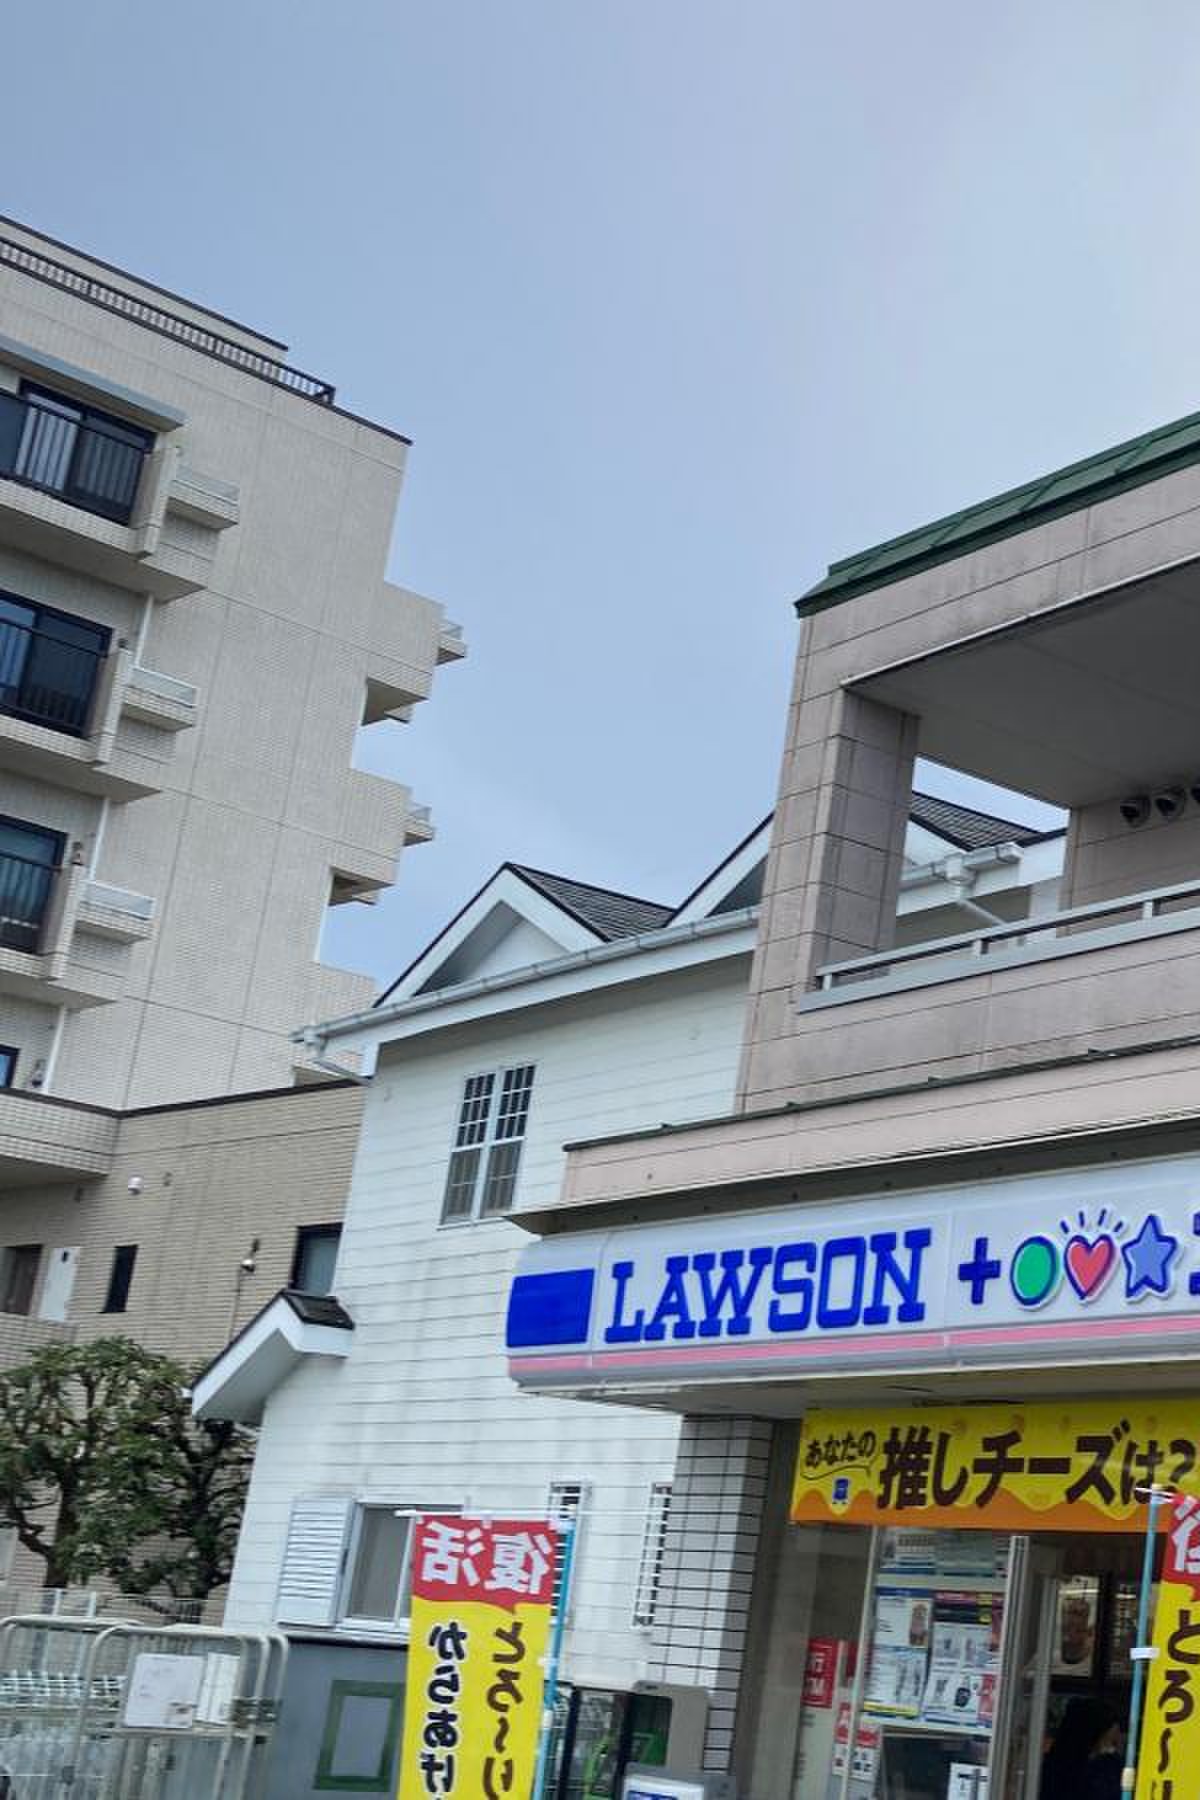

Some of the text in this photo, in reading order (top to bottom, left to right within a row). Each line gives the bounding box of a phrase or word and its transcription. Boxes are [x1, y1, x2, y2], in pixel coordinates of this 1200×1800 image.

[604, 1227, 931, 1343] LAWSON
[806, 1430, 876, 1469] あなたの
